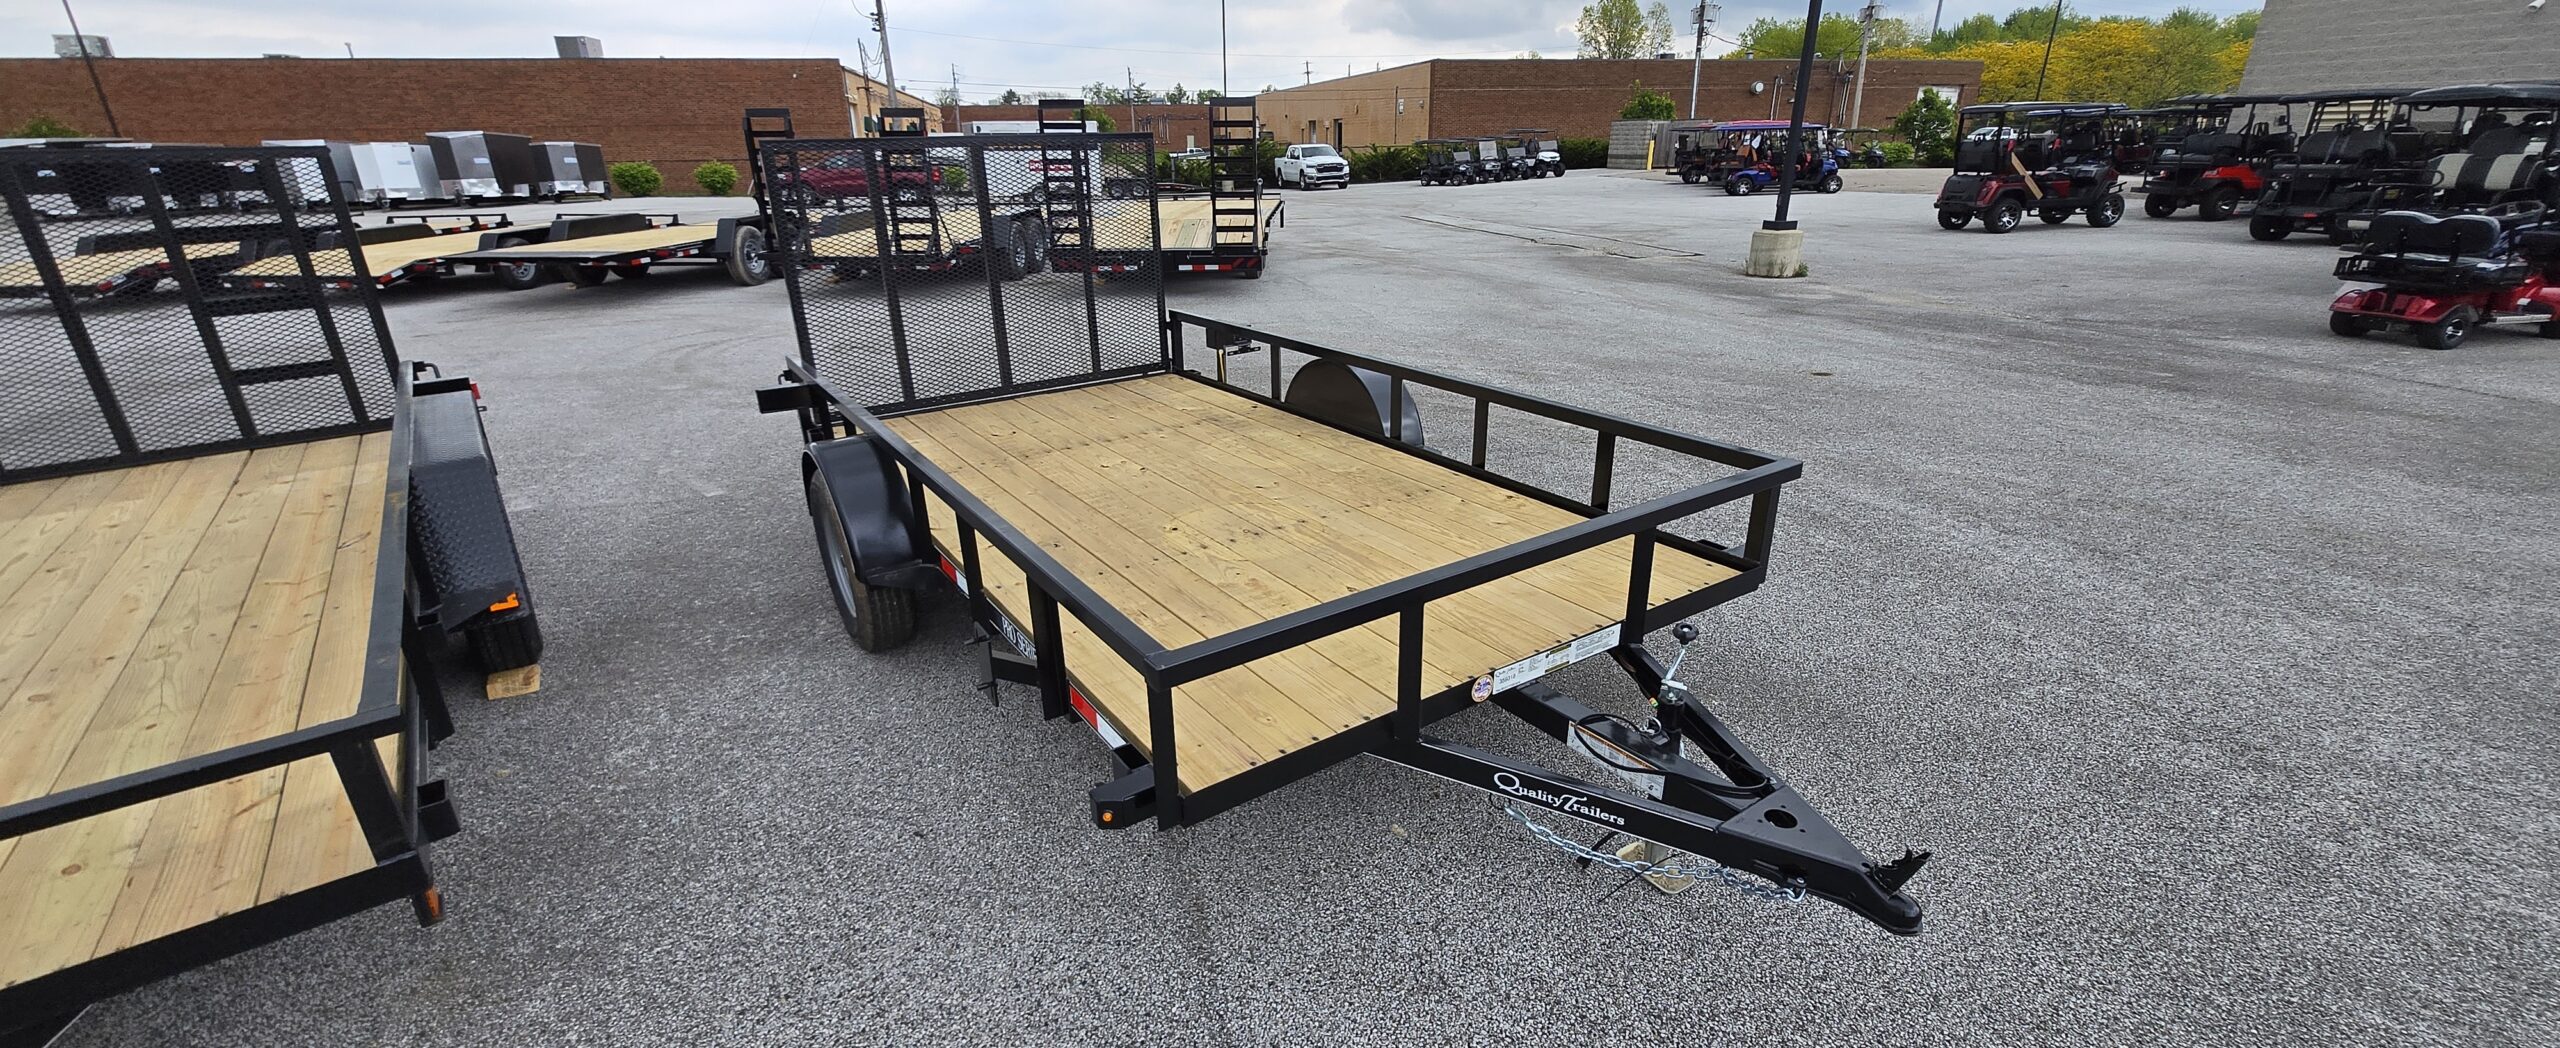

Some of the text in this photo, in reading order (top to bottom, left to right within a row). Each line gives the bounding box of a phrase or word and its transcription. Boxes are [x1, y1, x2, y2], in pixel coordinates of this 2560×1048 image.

[1001, 616, 1016, 643] PRO
[1493, 772, 1625, 826] Quality Trailers
